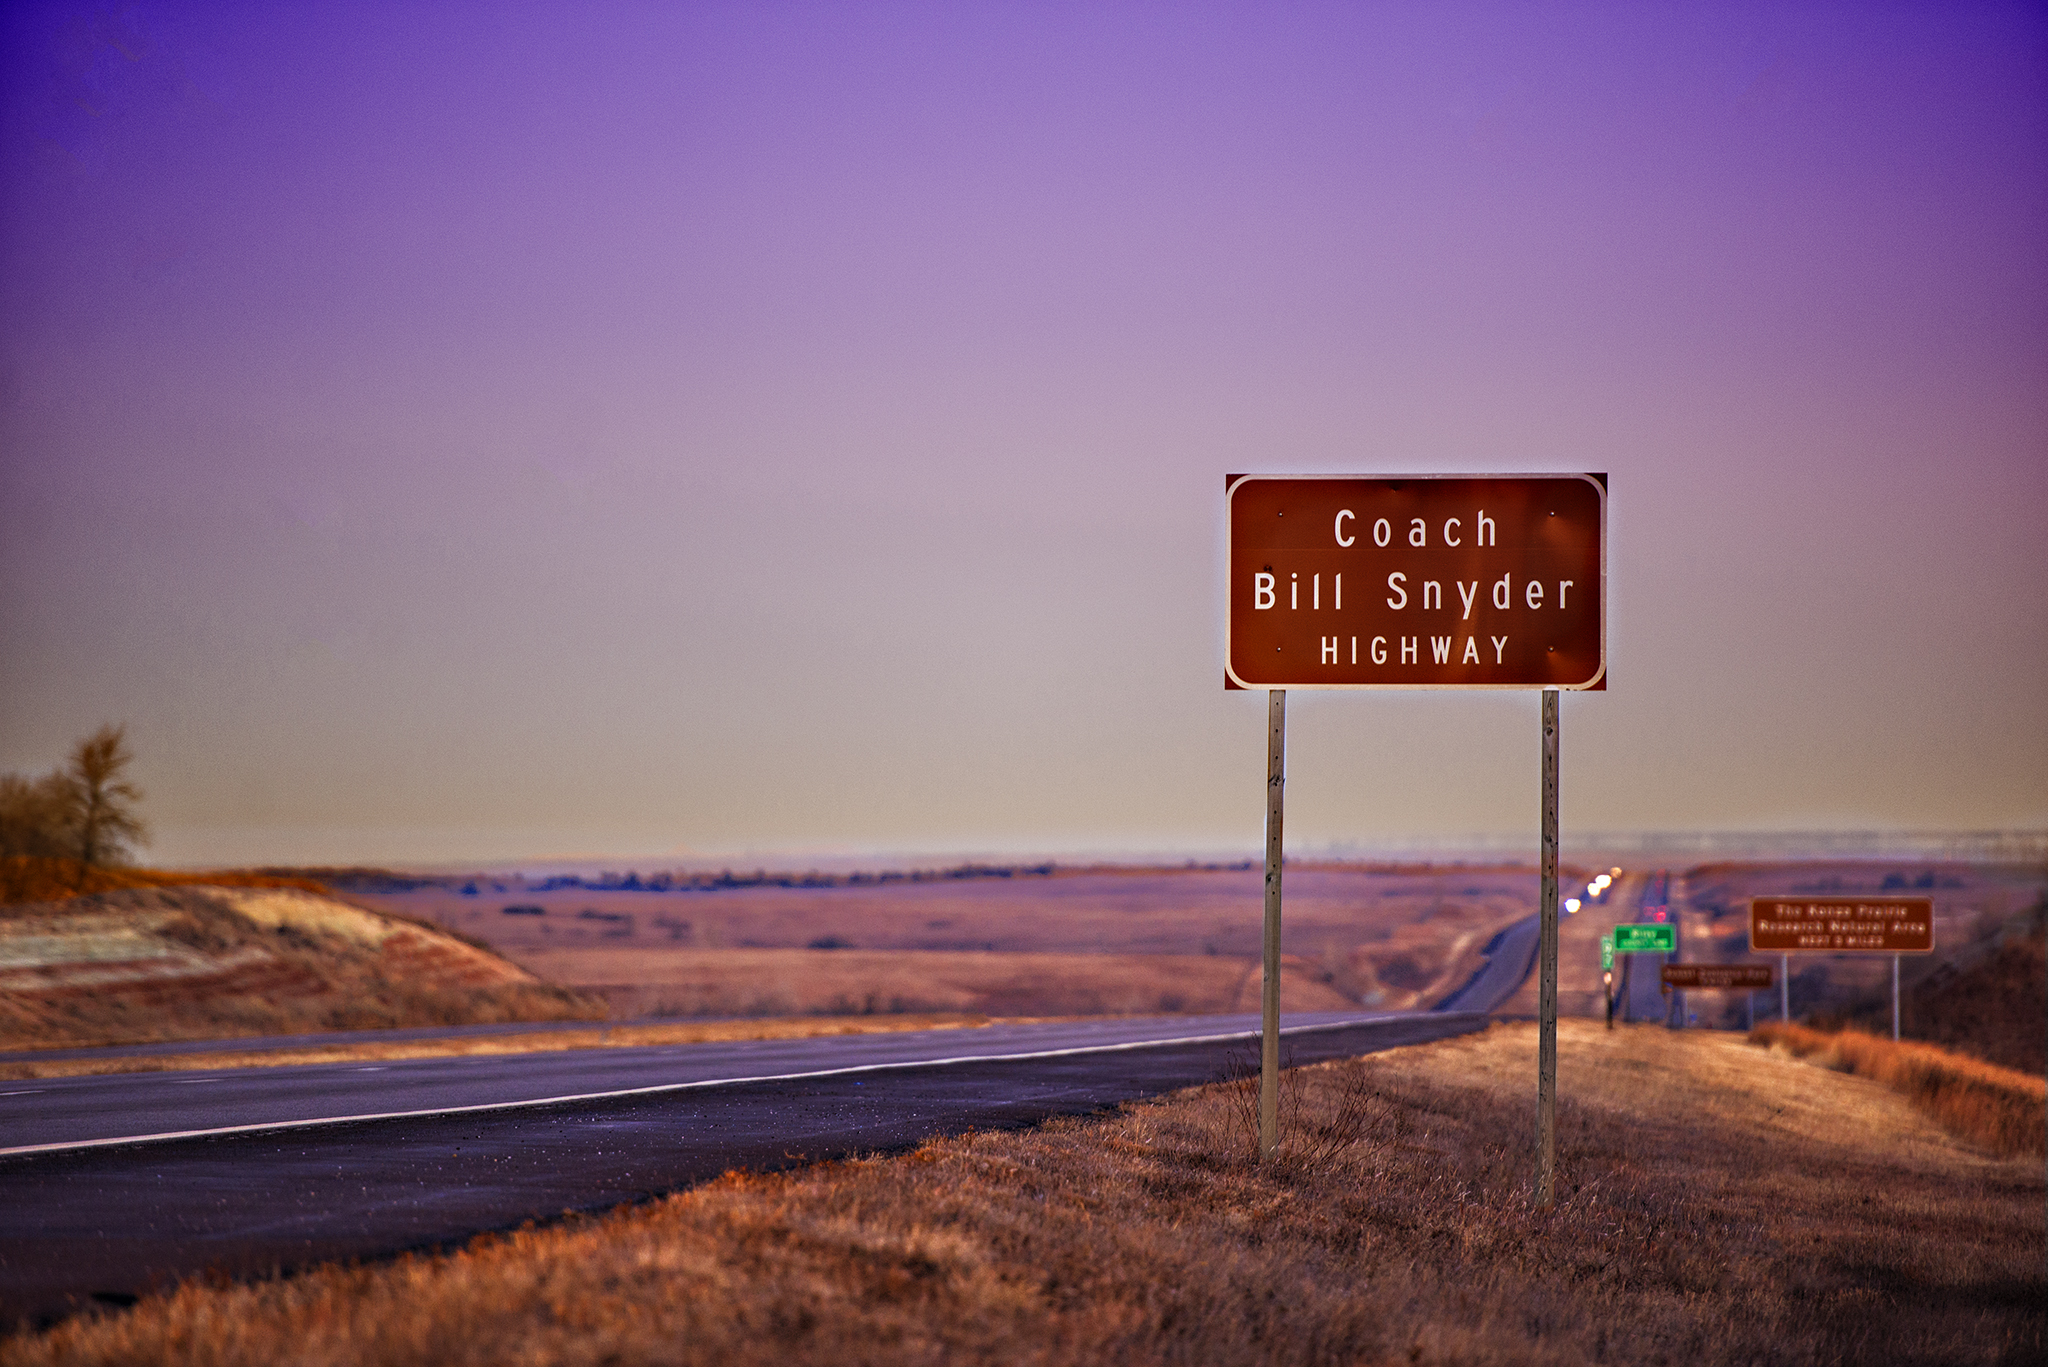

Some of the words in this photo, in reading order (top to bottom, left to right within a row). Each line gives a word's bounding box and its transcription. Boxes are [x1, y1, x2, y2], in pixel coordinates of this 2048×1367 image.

[1334, 509, 1496, 547] Coach
[1254, 572, 1342, 610] Bill
[1386, 571, 1574, 620] Snyder
[1321, 636, 1508, 665] HIGHWAY
[1775, 904, 1802, 918] The
[1857, 905, 1908, 918] Prairie
[1757, 919, 1824, 933] Research
[1829, 920, 1885, 933] Natural
[1892, 921, 1926, 933] Area
